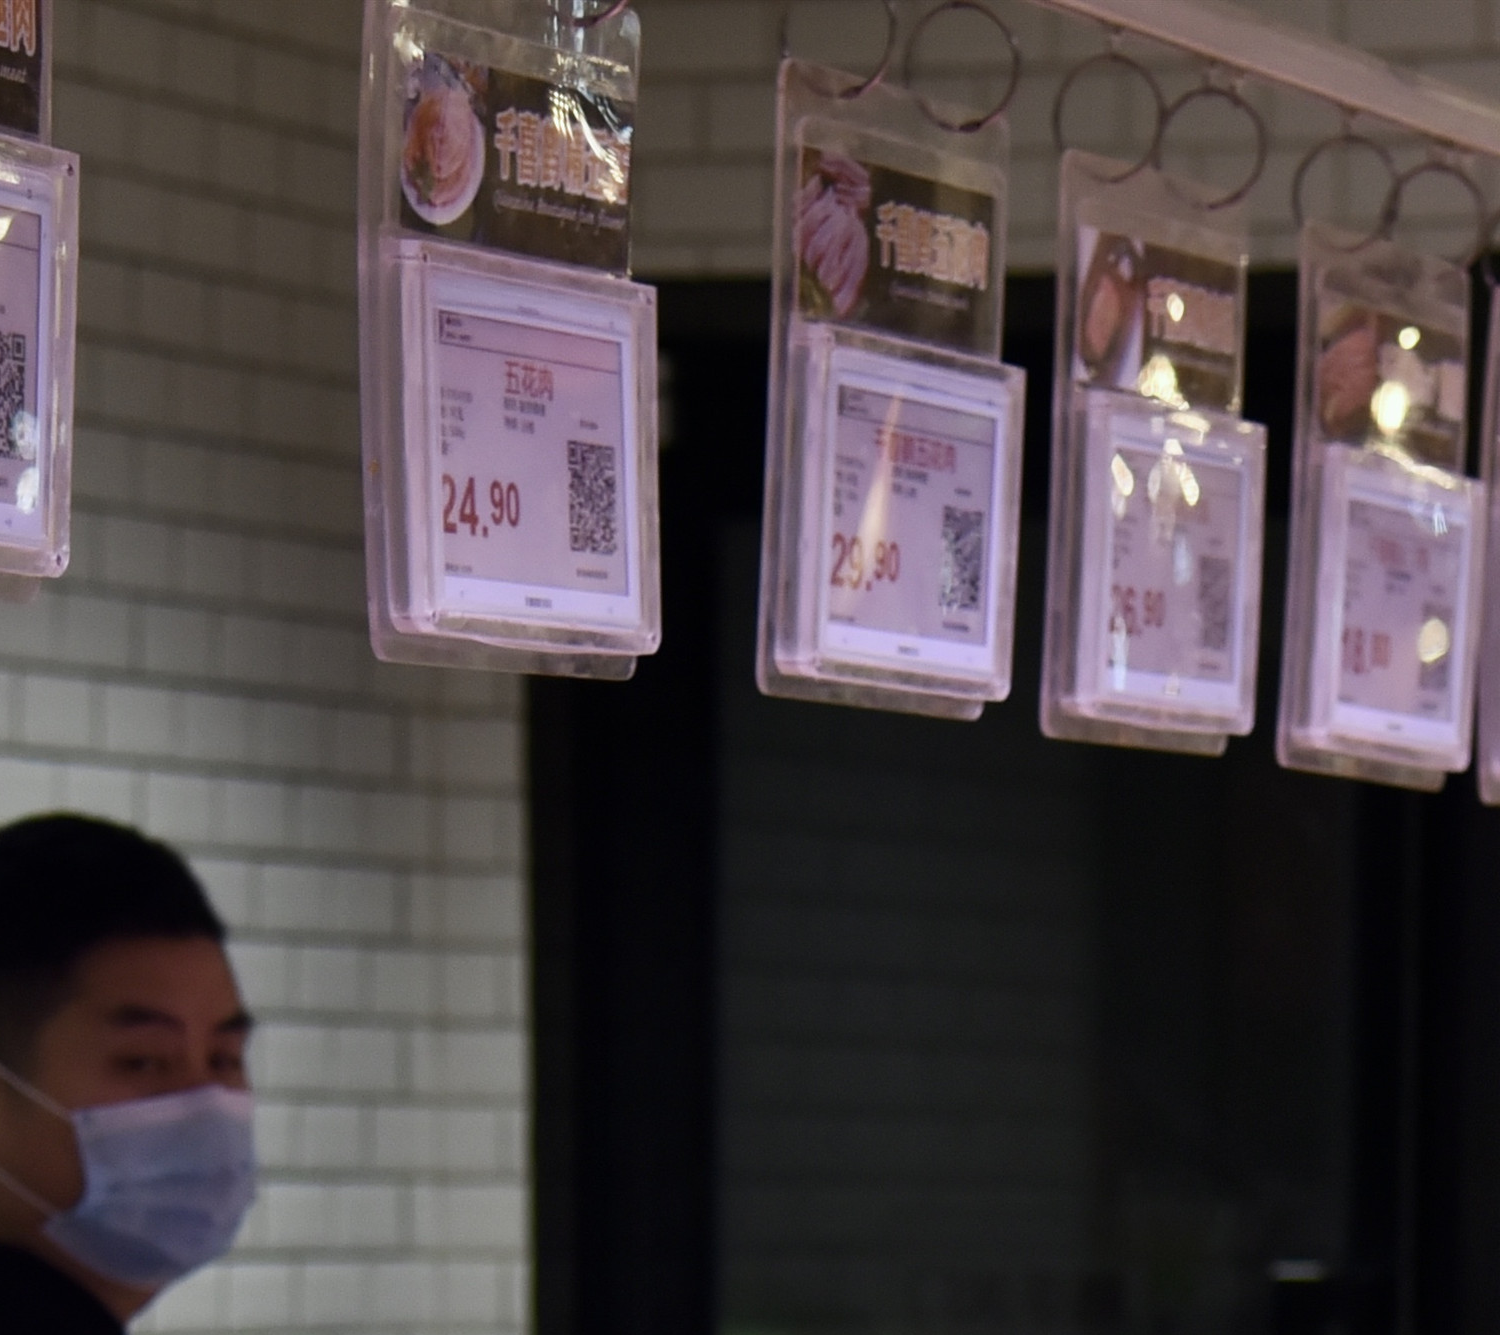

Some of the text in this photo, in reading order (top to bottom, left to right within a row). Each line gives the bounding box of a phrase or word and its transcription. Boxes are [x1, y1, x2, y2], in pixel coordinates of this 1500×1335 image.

[504, 360, 554, 402] 五花肉
[442, 473, 520, 538] 24.90
[830, 532, 899, 591] 29.90
